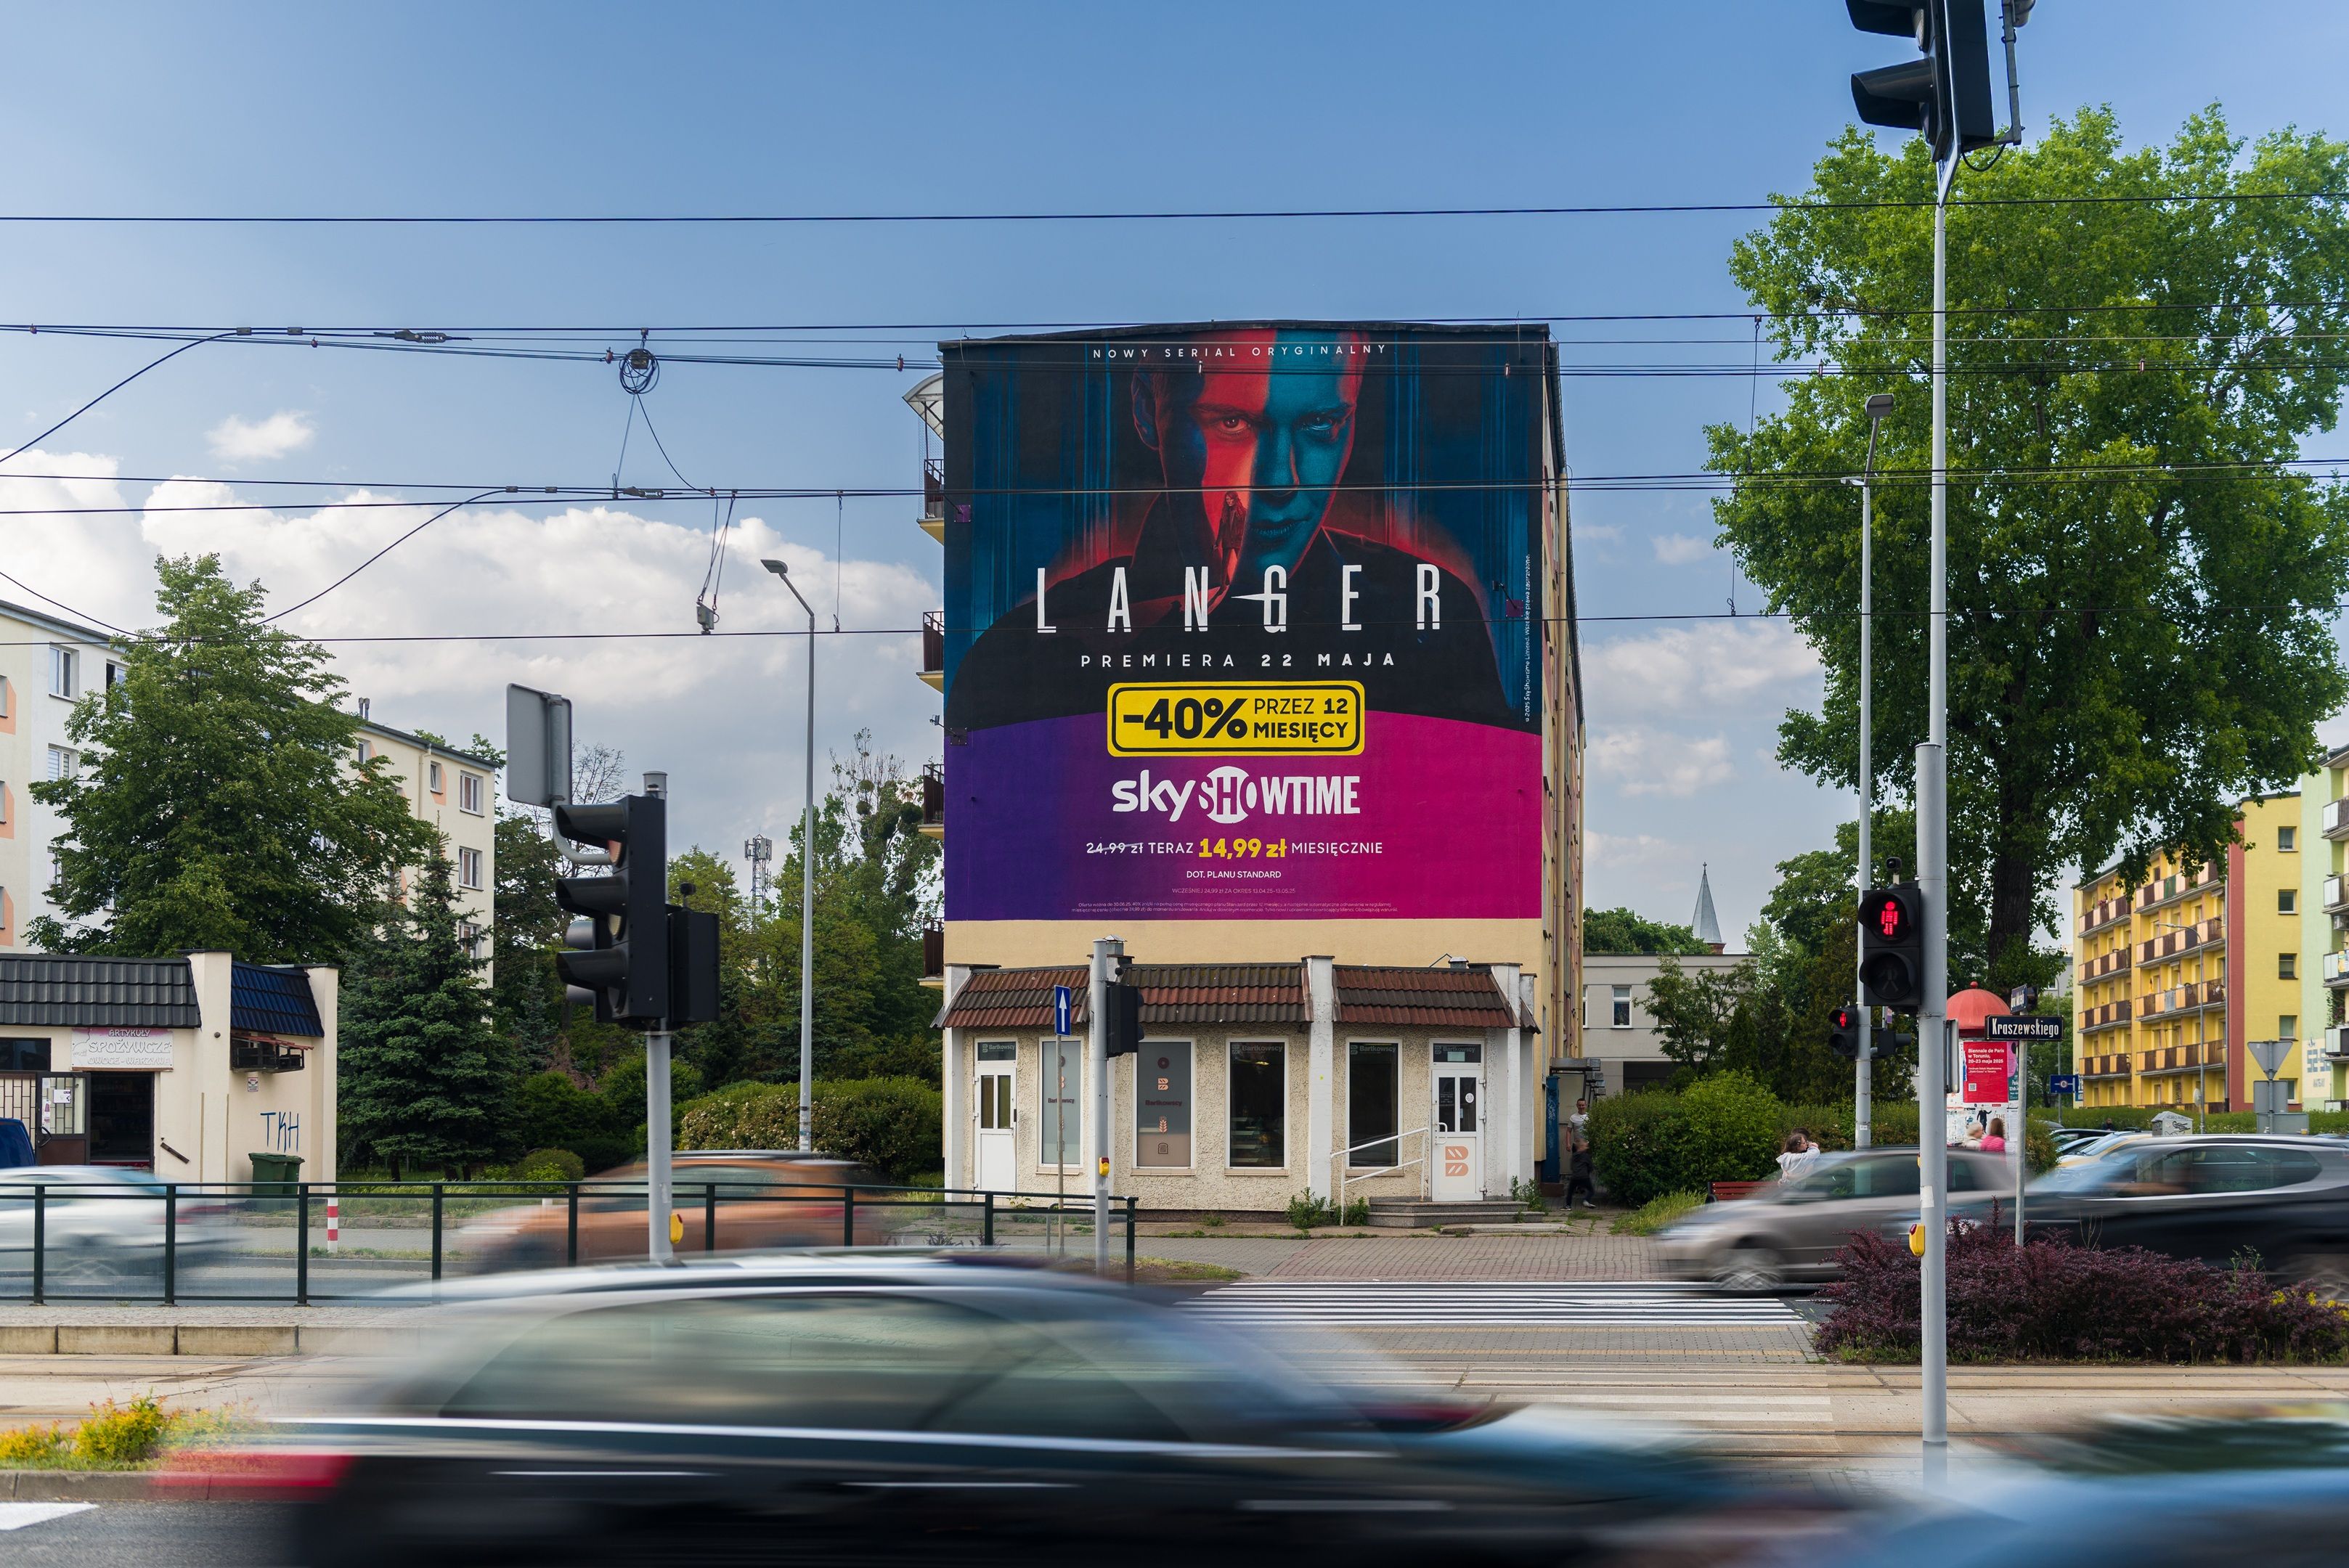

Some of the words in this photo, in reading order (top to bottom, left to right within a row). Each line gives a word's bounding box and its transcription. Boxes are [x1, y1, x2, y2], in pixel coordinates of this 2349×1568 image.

[1093, 348, 1149, 359] NOWY
[1164, 347, 1235, 357] SERIAL
[1251, 344, 1385, 356] ORYGINALNY
[1037, 563, 1441, 633] LANGER
[1080, 654, 1234, 667] PREMIERA
[1261, 654, 1292, 666] 22
[1317, 653, 1394, 666] MAJA
[1254, 698, 1314, 714] PRZEZ
[1324, 698, 1348, 714] 12
[1123, 698, 1248, 739] -40%
[1253, 722, 1348, 743] MIESIĘCY
[1086, 841, 1125, 856] 24,99
[1131, 841, 1144, 854] zł
[1148, 842, 1193, 854] TERAZ
[1198, 838, 1262, 859] 14,99
[1266, 838, 1287, 858] zł
[1292, 842, 1383, 857] MIESIĘCZNIE
[108, 1029, 151, 1037] ARTYKUŁY
[1992, 1018, 2059, 1038] Kraszewskiego
[88, 1038, 171, 1053] SPOŻYWCZE
[260, 1111, 299, 1153] TKH
